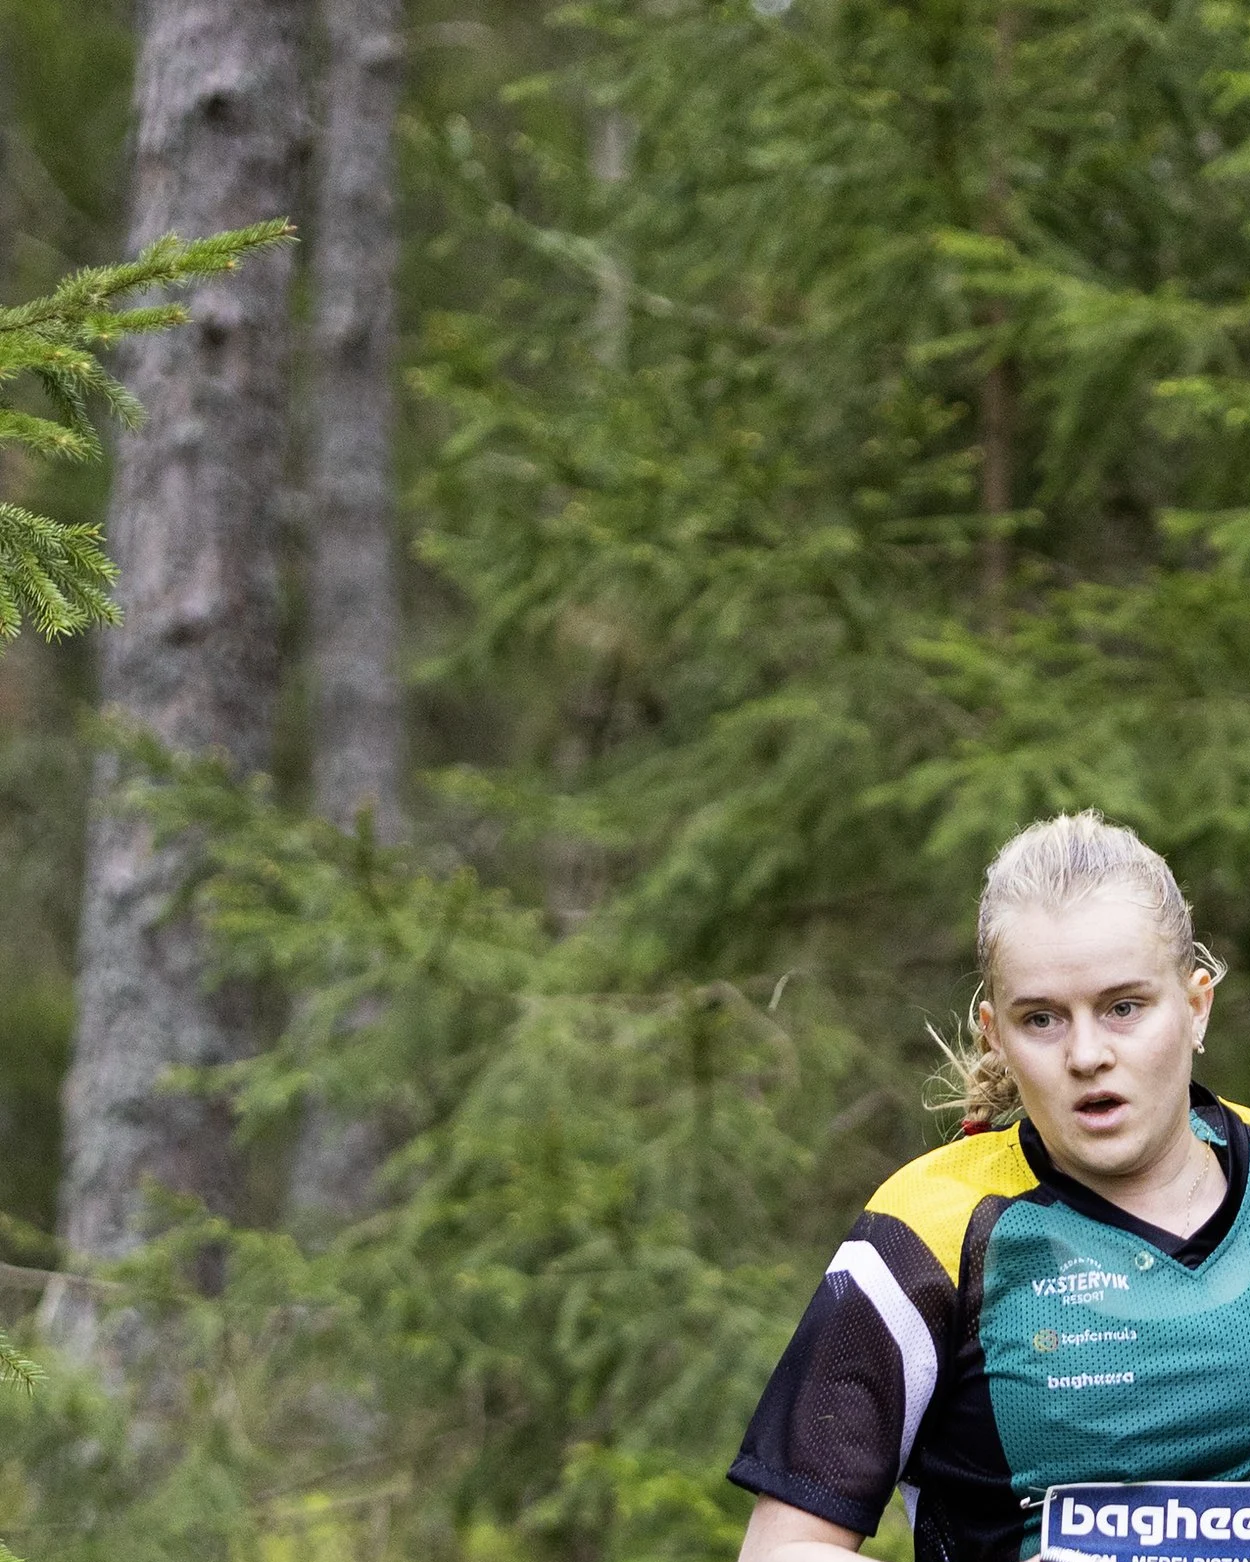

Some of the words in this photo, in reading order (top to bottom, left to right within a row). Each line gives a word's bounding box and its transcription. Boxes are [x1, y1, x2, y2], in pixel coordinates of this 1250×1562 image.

[1031, 1270, 1130, 1297] VÄSTERVIK
[1062, 1290, 1105, 1306] RESORT
[1061, 1327, 1138, 1346] topformula
[1047, 1372, 1134, 1390] bagheera
